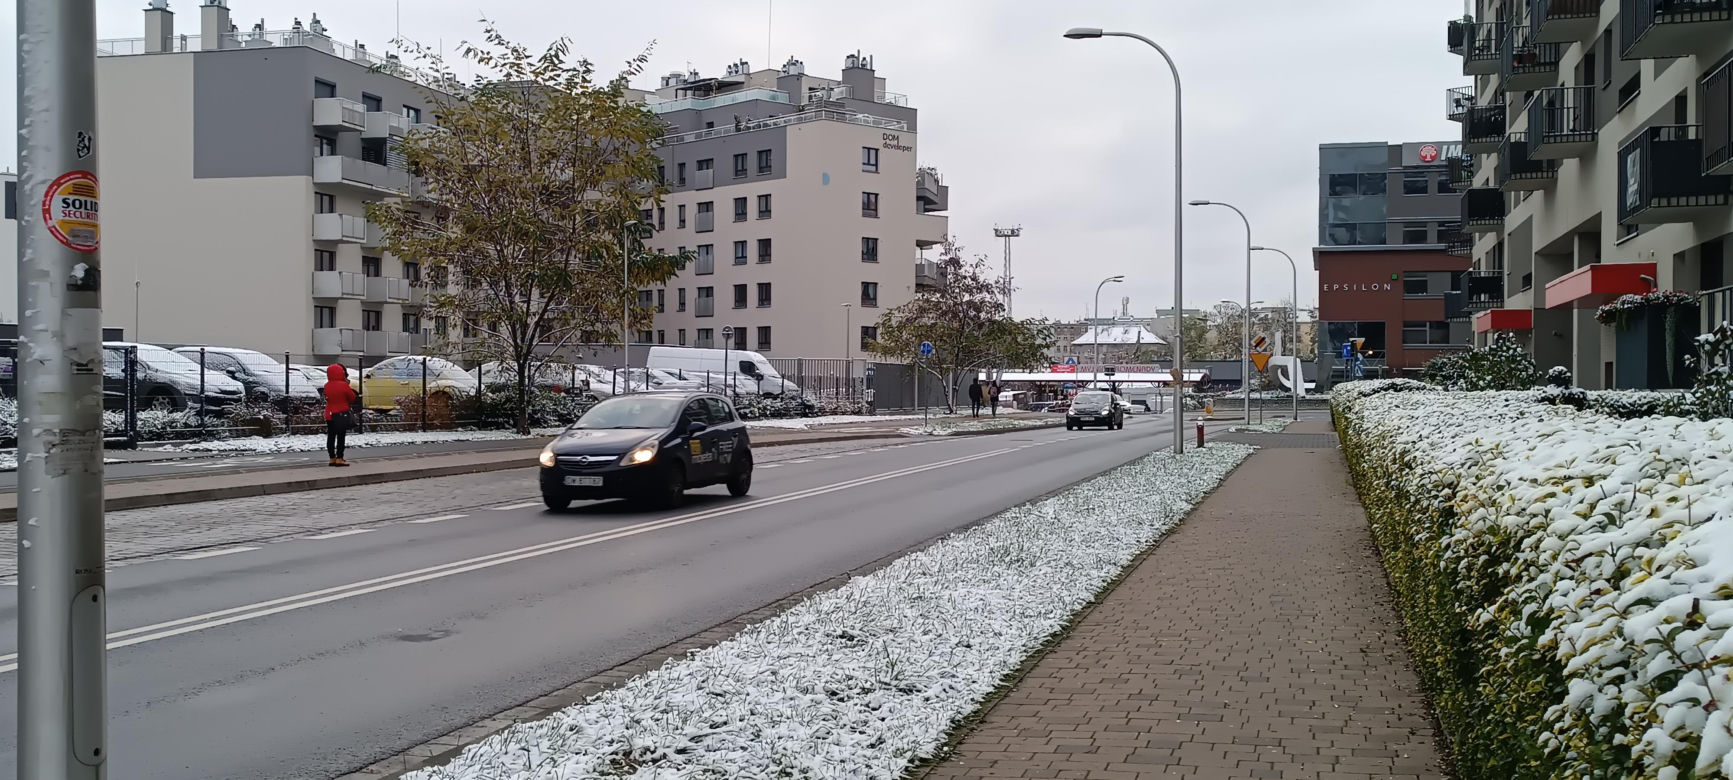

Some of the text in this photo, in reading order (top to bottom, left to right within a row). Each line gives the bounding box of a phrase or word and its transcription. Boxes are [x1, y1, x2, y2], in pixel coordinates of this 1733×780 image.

[882, 132, 900, 143] DOM
[882, 140, 913, 152] developer
[61, 197, 99, 213] SOLID
[1323, 283, 1392, 291] EPSILON
